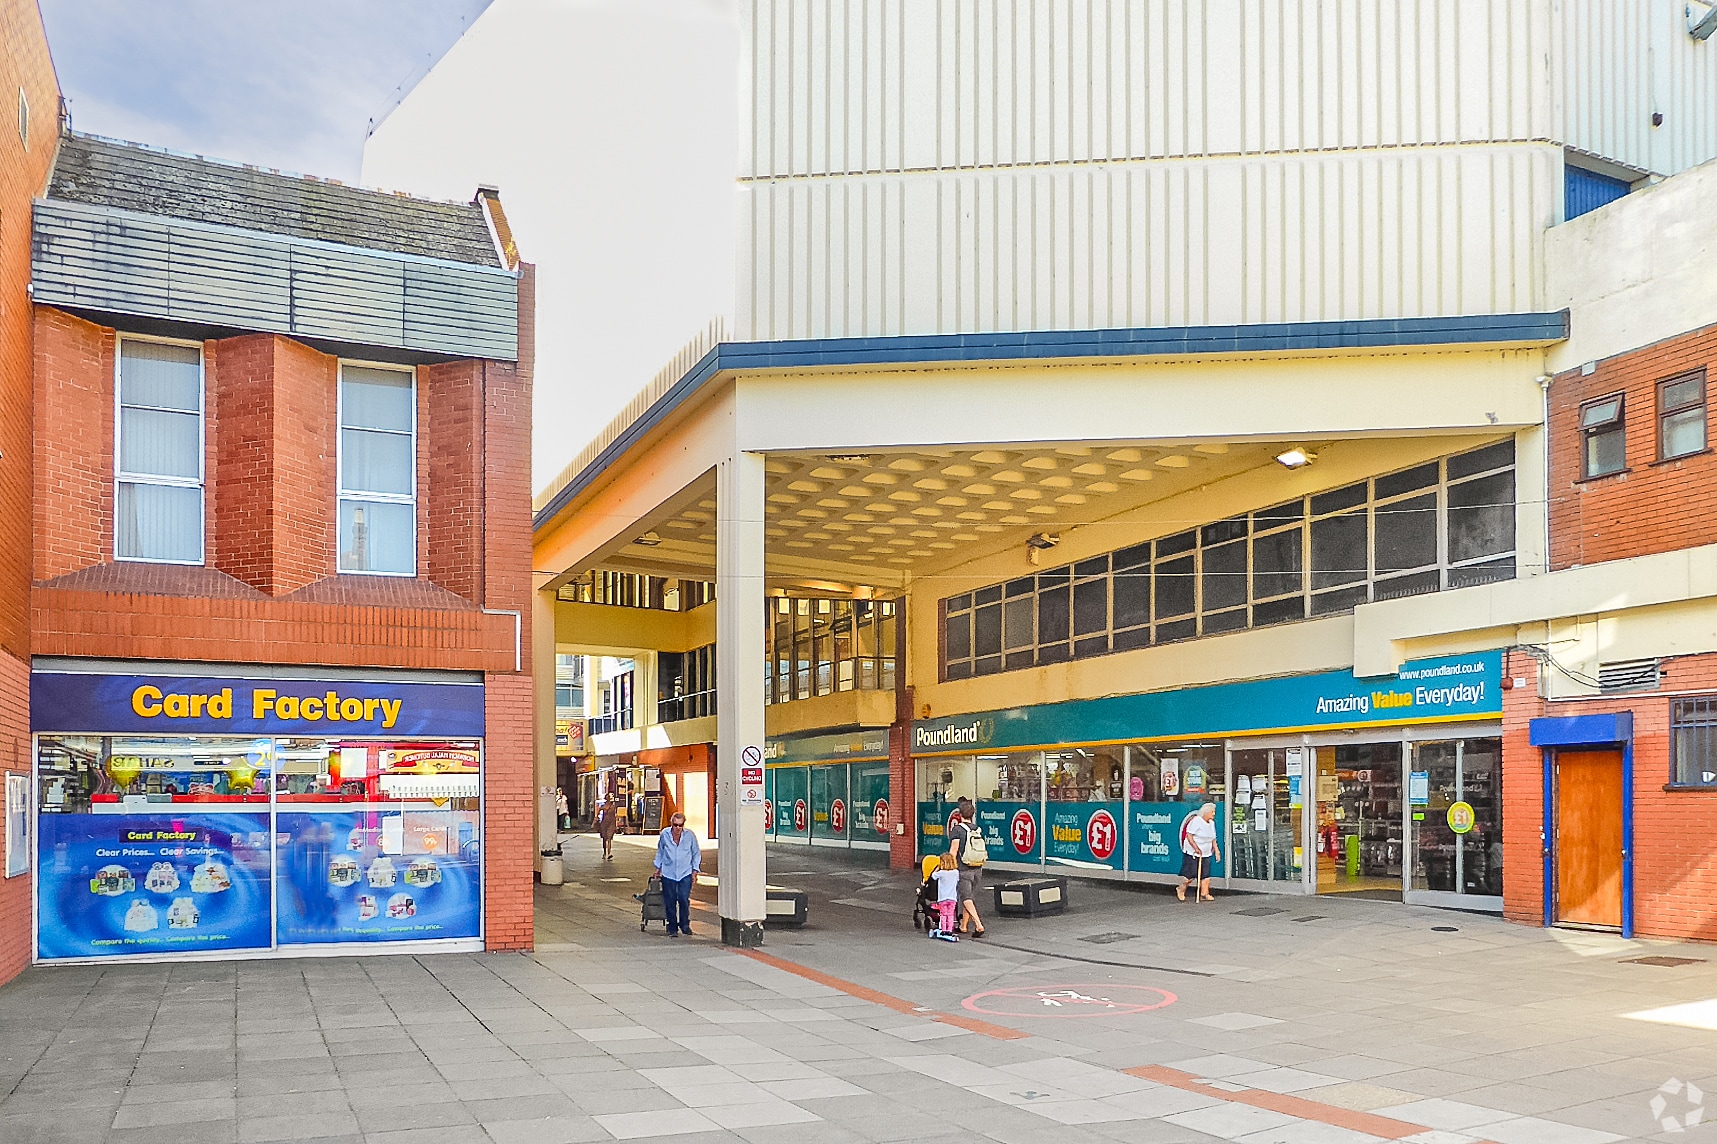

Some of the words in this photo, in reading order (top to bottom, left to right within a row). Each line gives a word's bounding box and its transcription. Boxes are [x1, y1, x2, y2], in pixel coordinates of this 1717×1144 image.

[1399, 661, 1485, 681] www.poundland.co.uk
[1315, 694, 1369, 714] Amazing
[1371, 690, 1413, 709] Value
[1415, 681, 1485, 707] Everyday!
[131, 685, 233, 719] Card
[252, 688, 403, 729] Factory
[916, 721, 979, 747] Poundland
[795, 806, 805, 826] £1
[832, 806, 843, 828] £1
[876, 807, 888, 830] £1
[980, 811, 1006, 820] Poundland
[1054, 813, 1079, 826] Amazing
[1136, 813, 1172, 824] Poundland
[127, 831, 153, 840] Card
[156, 831, 197, 841] Factory
[922, 821, 945, 836] Value
[989, 826, 999, 837] big
[1014, 820, 1032, 847] £1
[1051, 824, 1082, 842] Value
[1091, 821, 1112, 852] £1
[984, 836, 1004, 846] brands
[1148, 830, 1162, 845] big
[96, 848, 120, 857] Clear
[160, 847, 184, 856] Clear
[1140, 842, 1169, 856] brands
